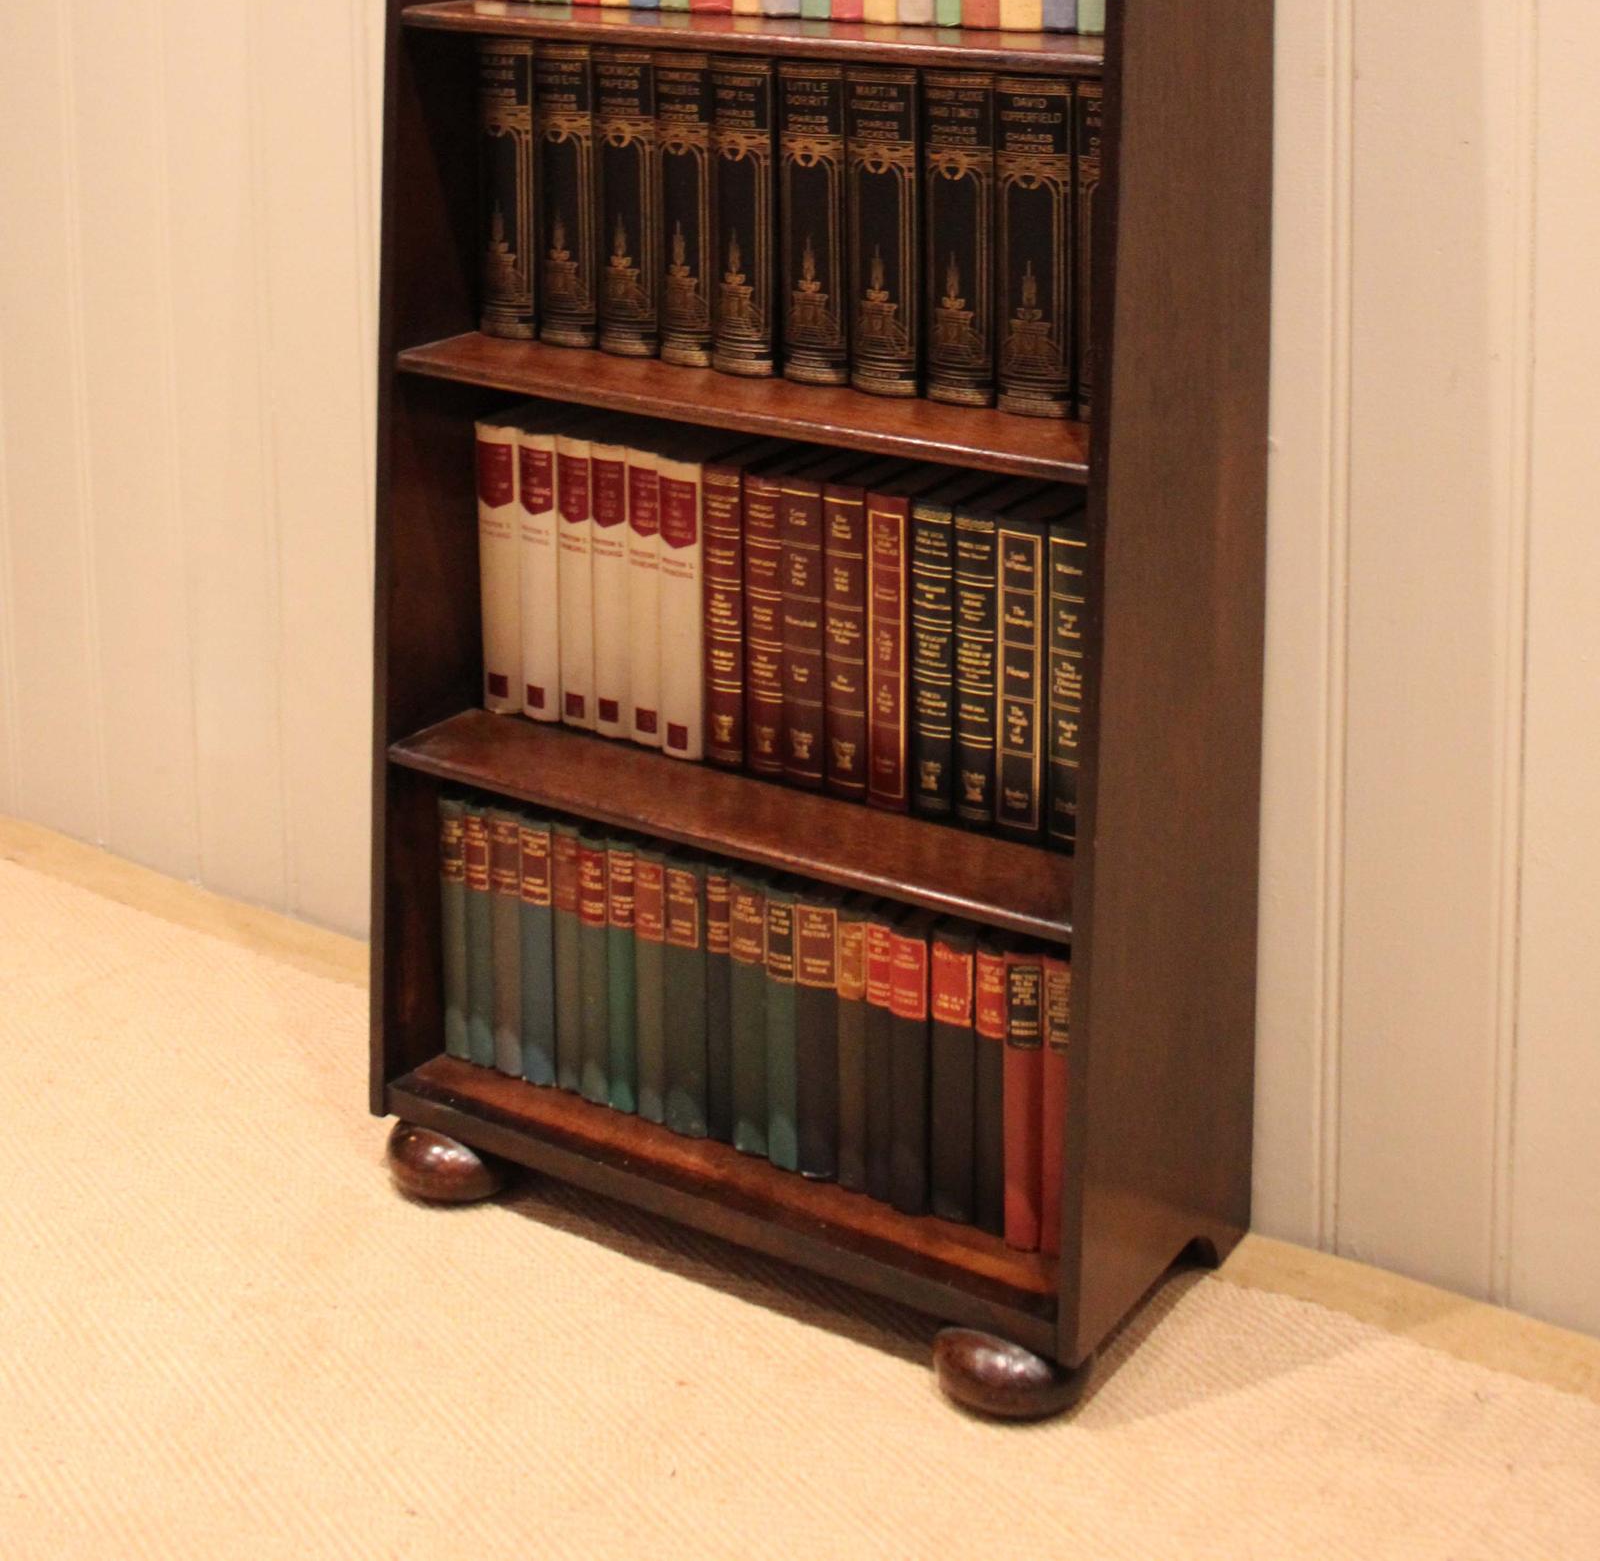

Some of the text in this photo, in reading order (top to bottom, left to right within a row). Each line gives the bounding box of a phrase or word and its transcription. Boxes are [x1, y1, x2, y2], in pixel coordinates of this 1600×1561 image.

[785, 81, 829, 93] LITTLE
[856, 85, 899, 98] MARTIN
[1011, 96, 1049, 110] DAVID
[787, 113, 829, 124] CHARLES
[857, 118, 900, 130] CHARLES
[787, 123, 830, 135] DICKENS
[857, 128, 901, 141] DICKENS
[930, 123, 977, 135] CHARLES
[930, 133, 978, 145] DICKENS
[1005, 132, 1055, 144] CHARLES
[1005, 142, 1055, 154] DICKENS
